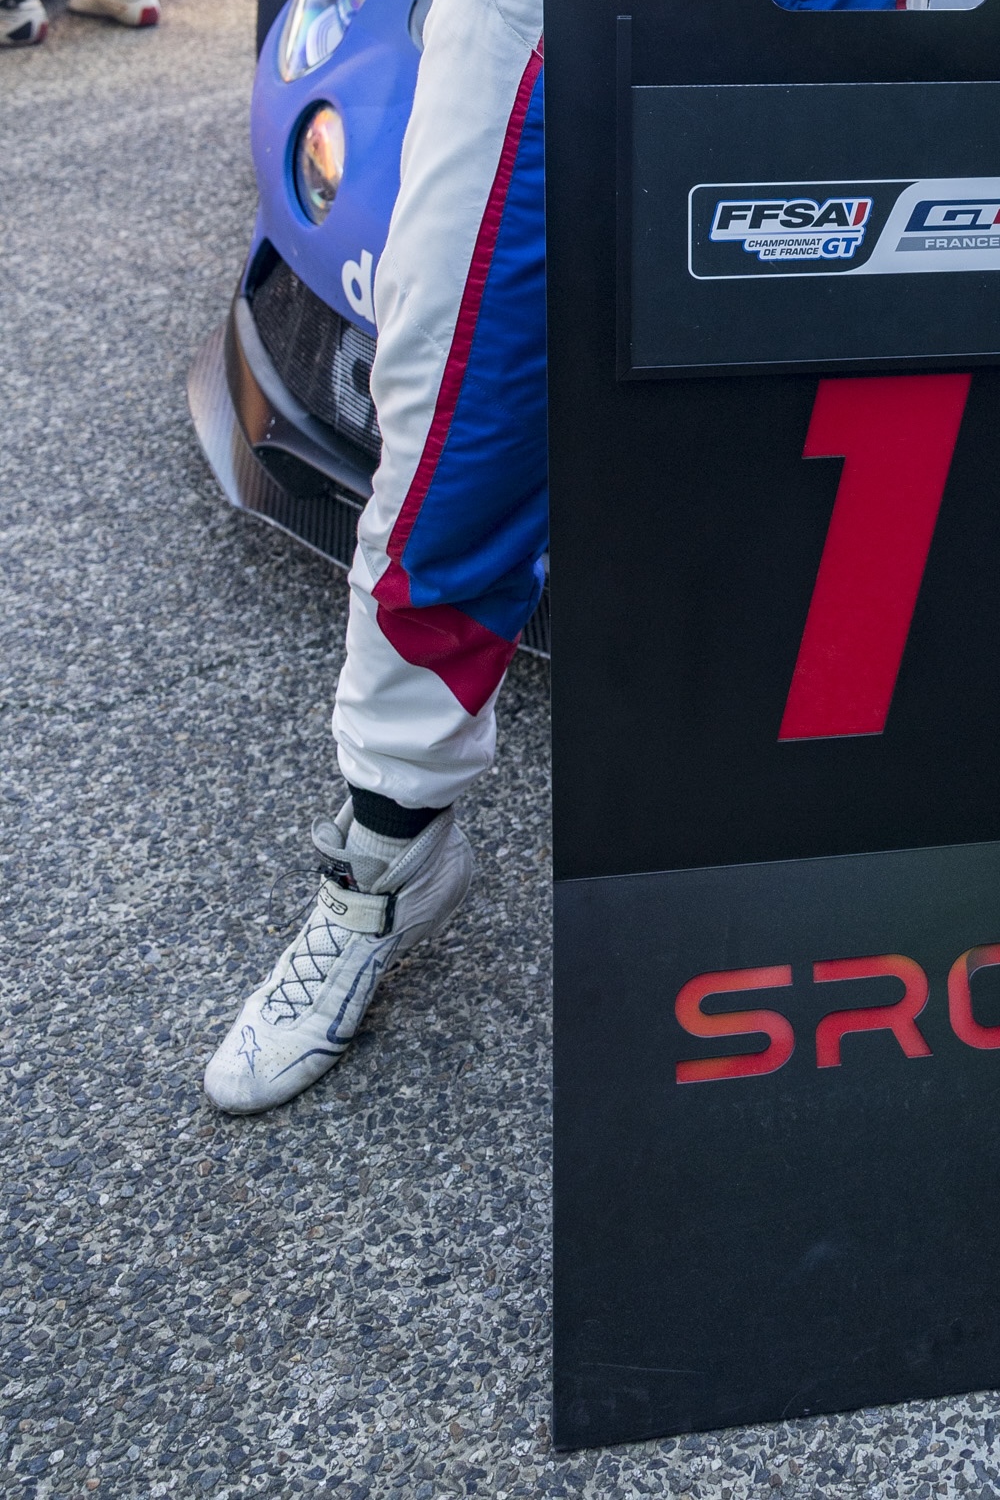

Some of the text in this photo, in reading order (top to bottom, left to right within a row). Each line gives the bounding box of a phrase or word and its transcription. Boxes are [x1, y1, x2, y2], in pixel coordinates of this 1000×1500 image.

[716, 202, 853, 231] FFSA
[748, 237, 1000, 255] CHAMPIONNAT GT FRANCE
[763, 247, 819, 257] DE FRANCE
[779, 373, 973, 741] 1
